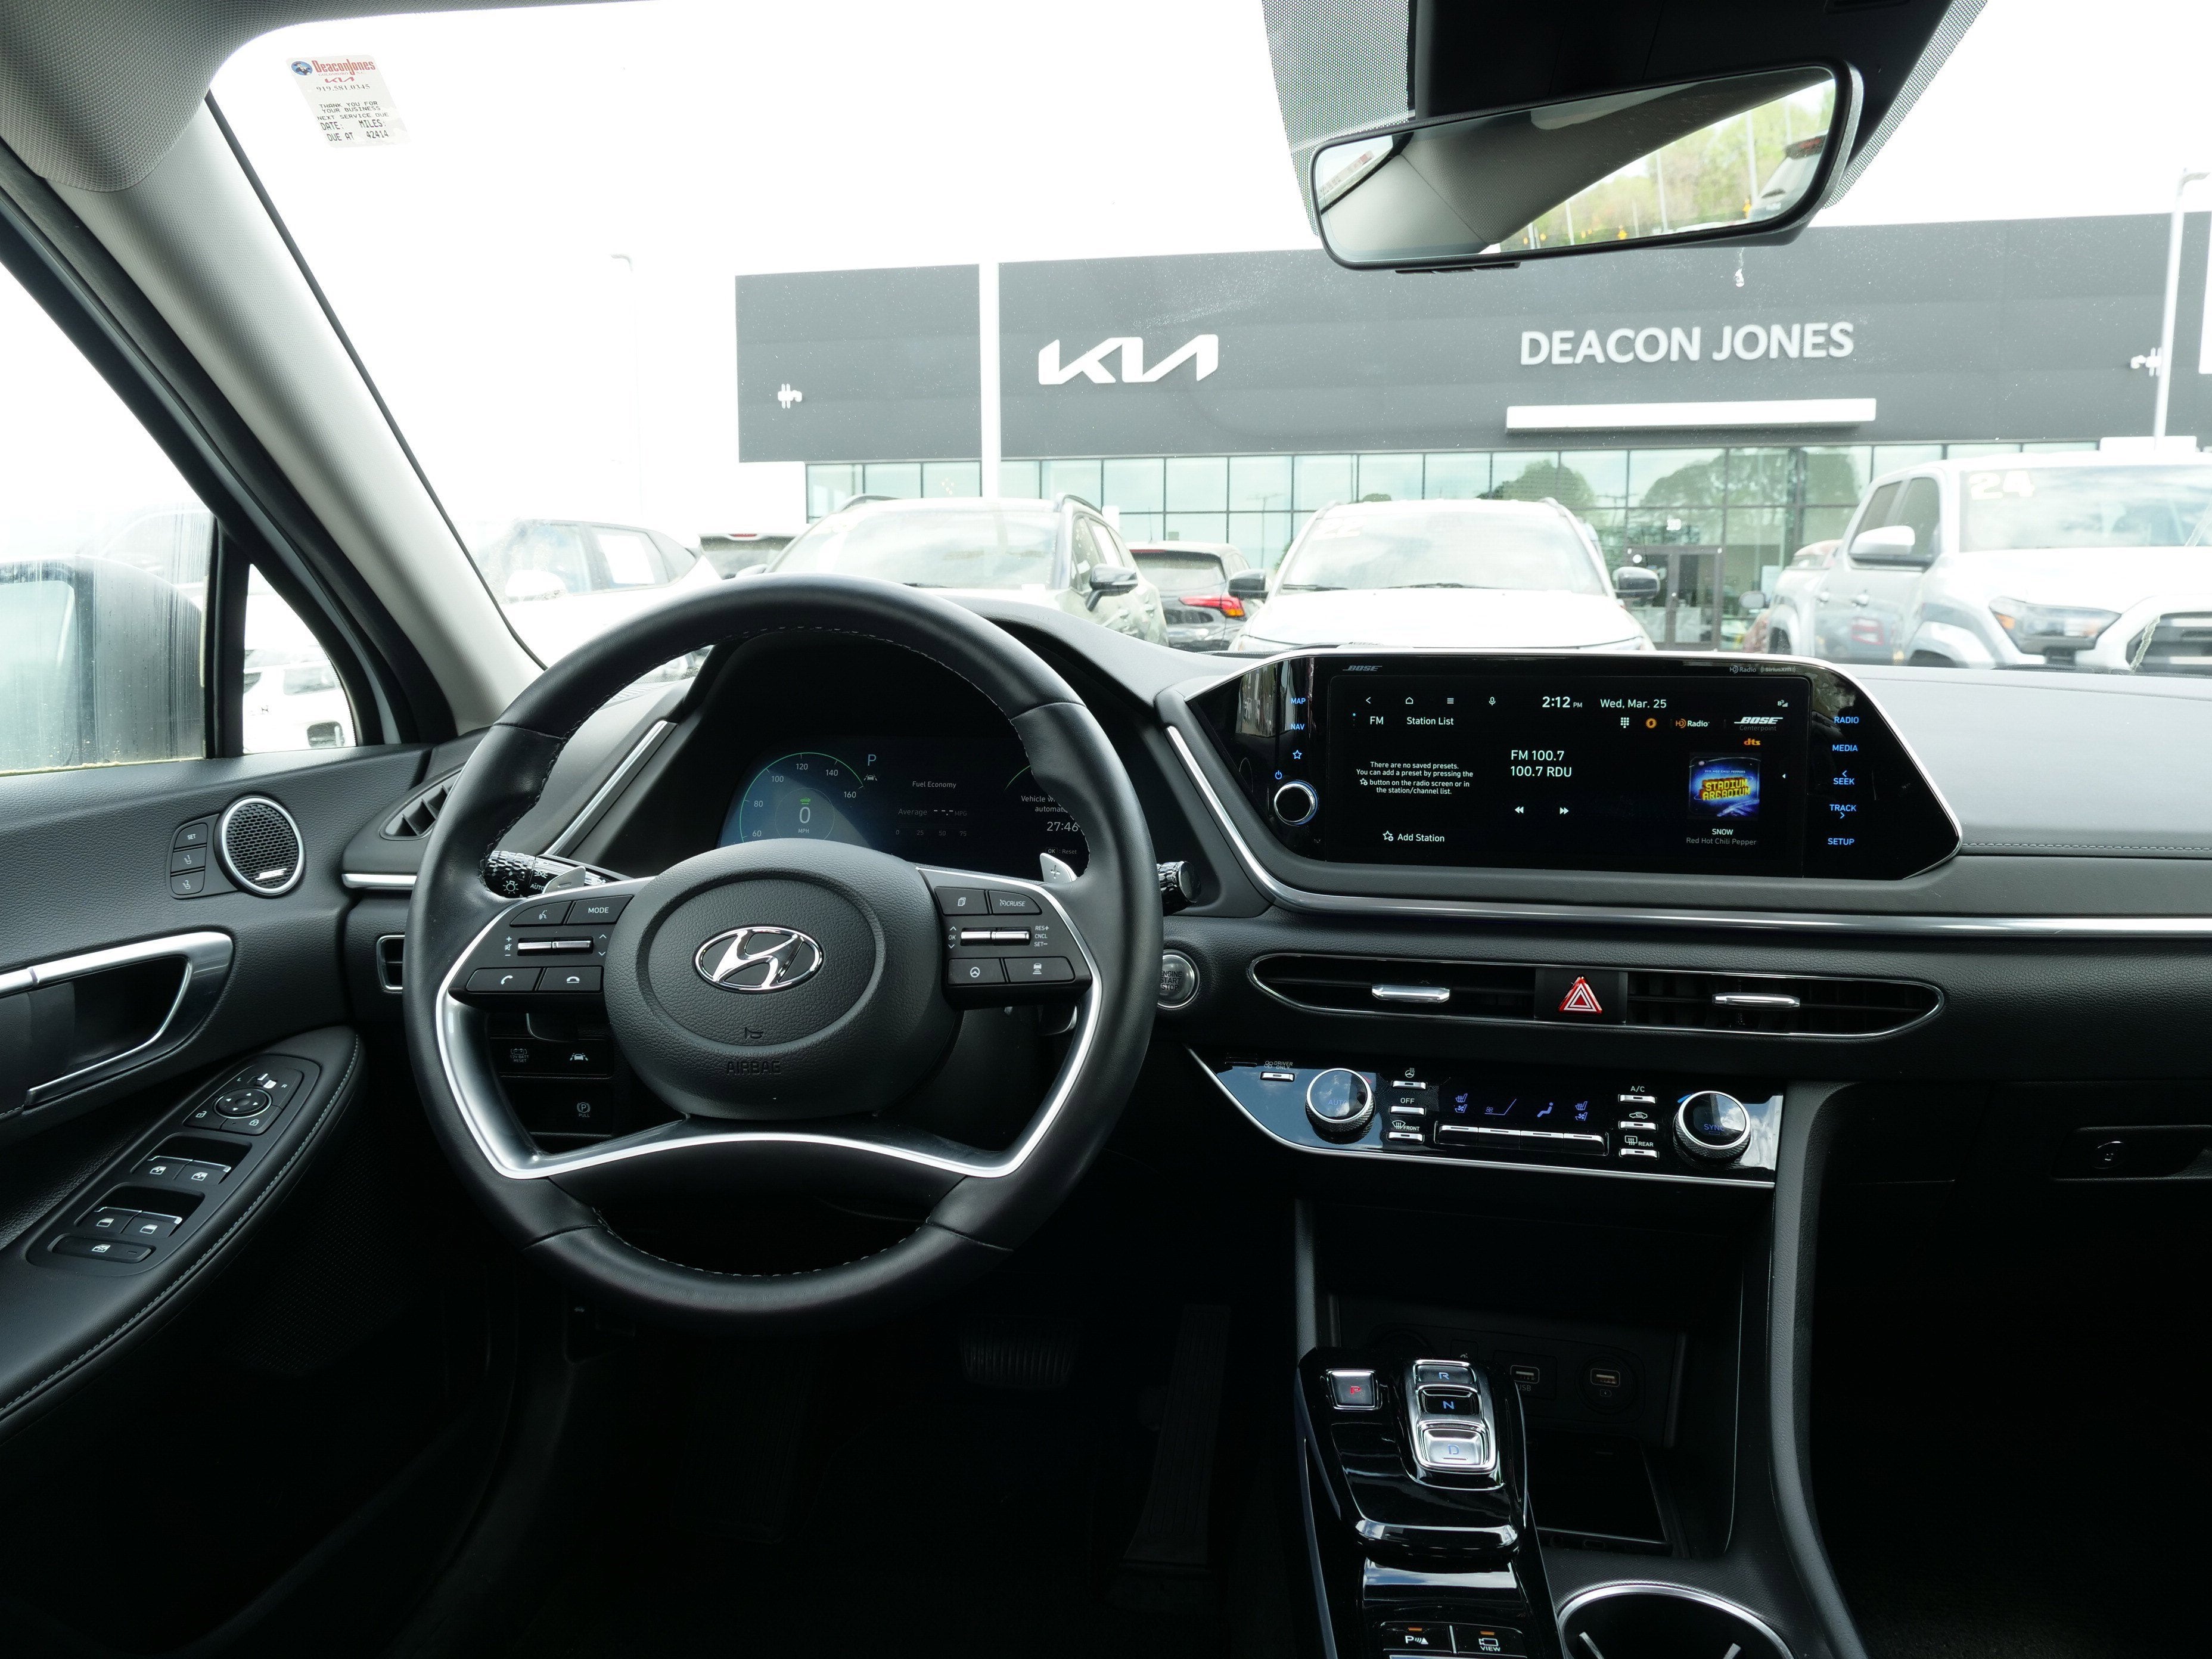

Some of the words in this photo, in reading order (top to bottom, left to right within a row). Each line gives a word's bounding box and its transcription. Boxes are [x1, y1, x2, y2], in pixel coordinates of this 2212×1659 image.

[320, 122, 344, 131] DATE:
[358, 119, 386, 128] MILES:
[327, 133, 342, 141] DUE
[345, 132, 355, 140] AT
[366, 130, 389, 138] 42414
[1521, 327, 1642, 365] DEACON
[1712, 322, 1854, 361] JONES
[1039, 334, 1218, 384] KIA
[1969, 471, 2035, 501] 24
[1542, 697, 1570, 708] 2:12
[1601, 699, 1624, 709] Wed,
[1628, 700, 1650, 709] Mar.
[1654, 700, 1667, 709] 25
[1370, 716, 1384, 725] FM
[1407, 716, 1436, 725] Station
[1438, 717, 1454, 725] List
[867, 754, 877, 766] P
[1511, 750, 1528, 760] FM
[1531, 750, 1565, 761] 100.7
[1510, 766, 1543, 776] 100.7
[1546, 767, 1572, 777] RDU
[1705, 778, 1748, 791] STADIUM
[1703, 787, 1751, 800] ARCADIUM
[799, 807, 811, 824] 0
[898, 809, 927, 817] Average
[1047, 819, 1079, 832] 27:46
[1397, 833, 1413, 841] Add
[1415, 834, 1445, 842] Station
[728, 1061, 782, 1075] AIRBAG
[1439, 1372, 1450, 1380] R
[1350, 1386, 1362, 1394] P
[1442, 1400, 1455, 1410] N
[1448, 1444, 1460, 1455] D
